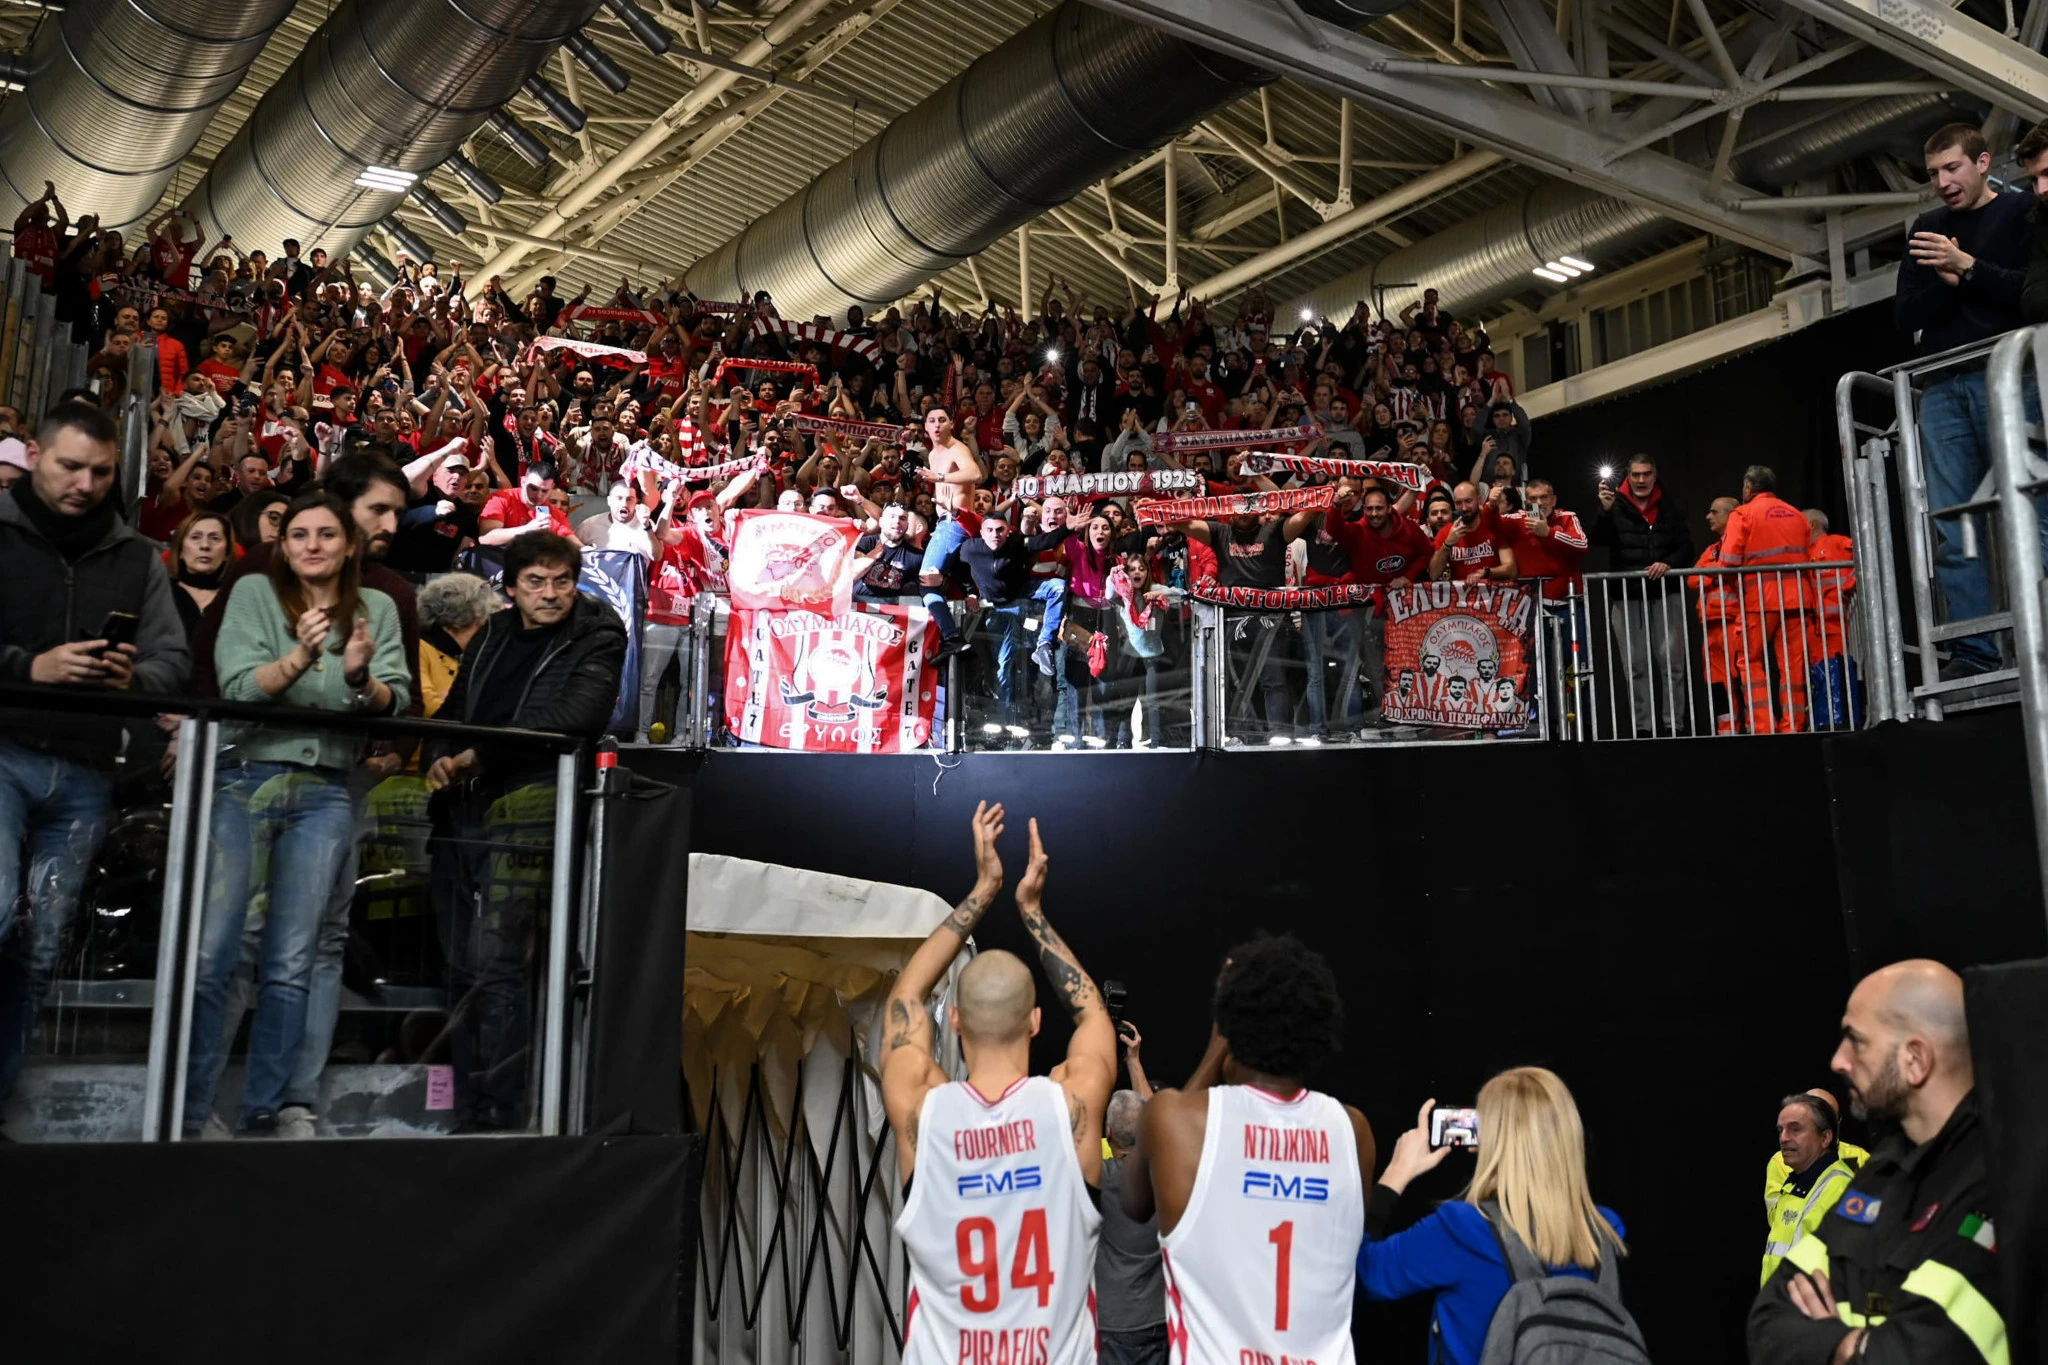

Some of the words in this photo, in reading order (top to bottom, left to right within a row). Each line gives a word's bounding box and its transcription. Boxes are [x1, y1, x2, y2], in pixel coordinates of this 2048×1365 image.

[1018, 477, 1039, 498] 10
[1044, 472, 1145, 496] ΜΑΡΤΙΟΥ
[1151, 469, 1197, 491] 1925
[954, 1119, 1036, 1162] FOURNIER
[1244, 1123, 1329, 1164] NTILIKINA
[957, 1166, 1042, 1197] FMS
[1243, 1171, 1329, 1201] FMS
[955, 1207, 1055, 1313] 94
[1269, 1220, 1294, 1332] 1
